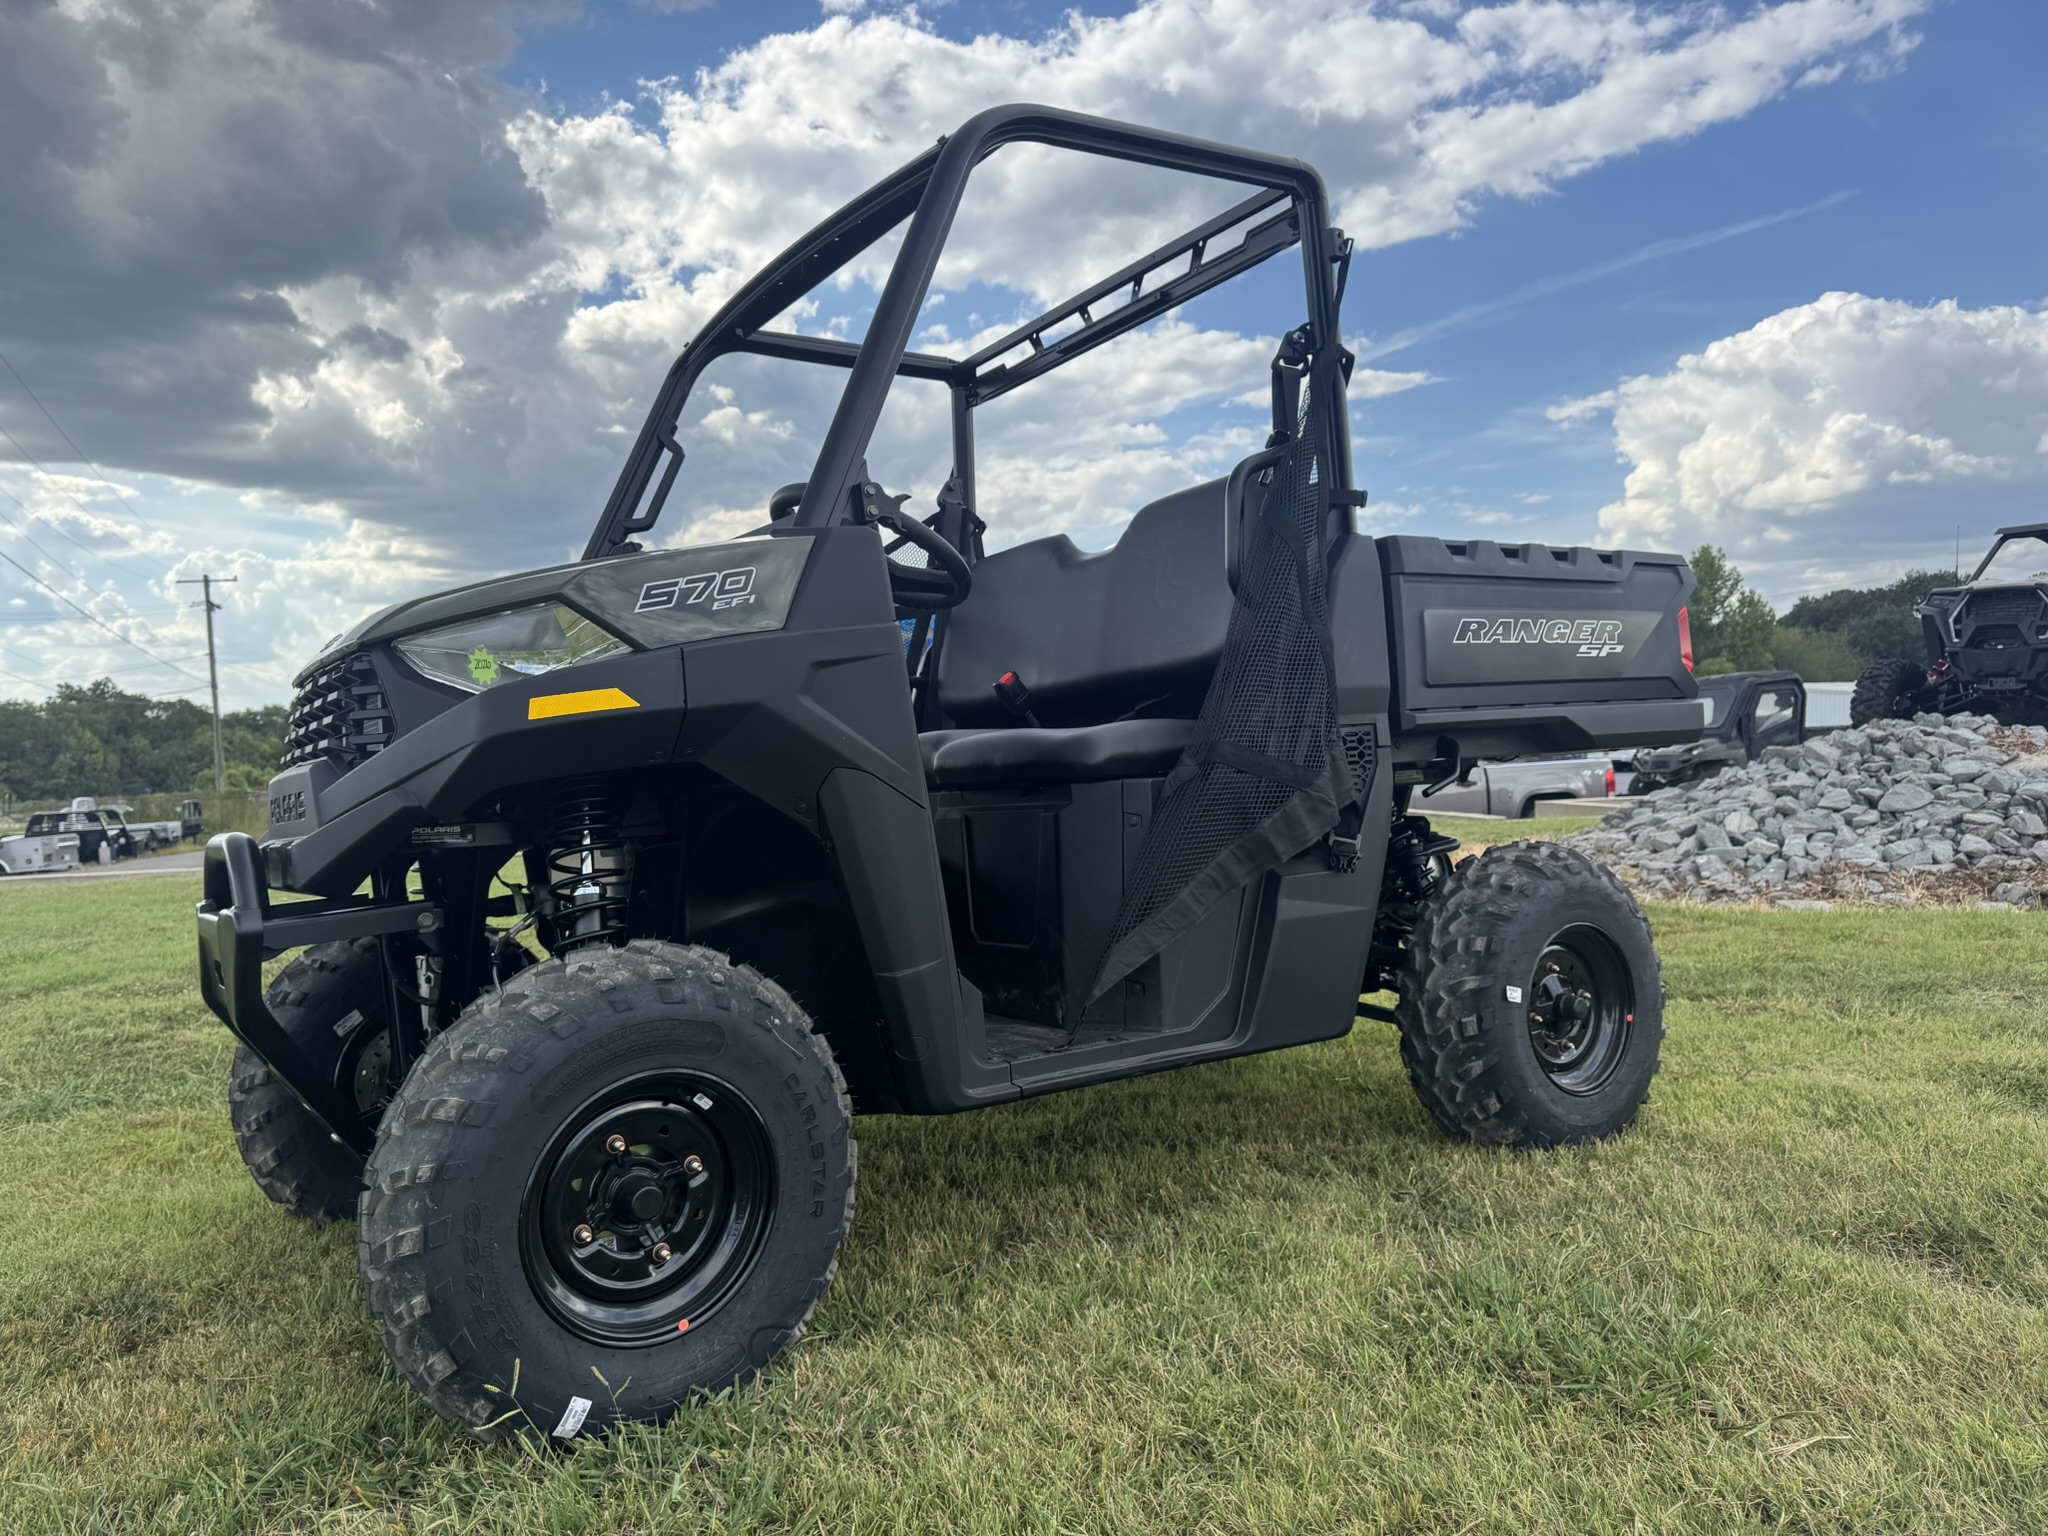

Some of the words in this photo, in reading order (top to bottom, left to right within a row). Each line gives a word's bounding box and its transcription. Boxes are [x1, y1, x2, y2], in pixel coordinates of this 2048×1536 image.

[633, 566, 756, 613] 570
[711, 594, 756, 611] EFI
[1452, 618, 1623, 644] RANGER
[1575, 645, 1625, 657] SP
[473, 658, 492, 670] 2026
[411, 821, 461, 834] POLARIS
[783, 1071, 826, 1219] CARLSTAR
